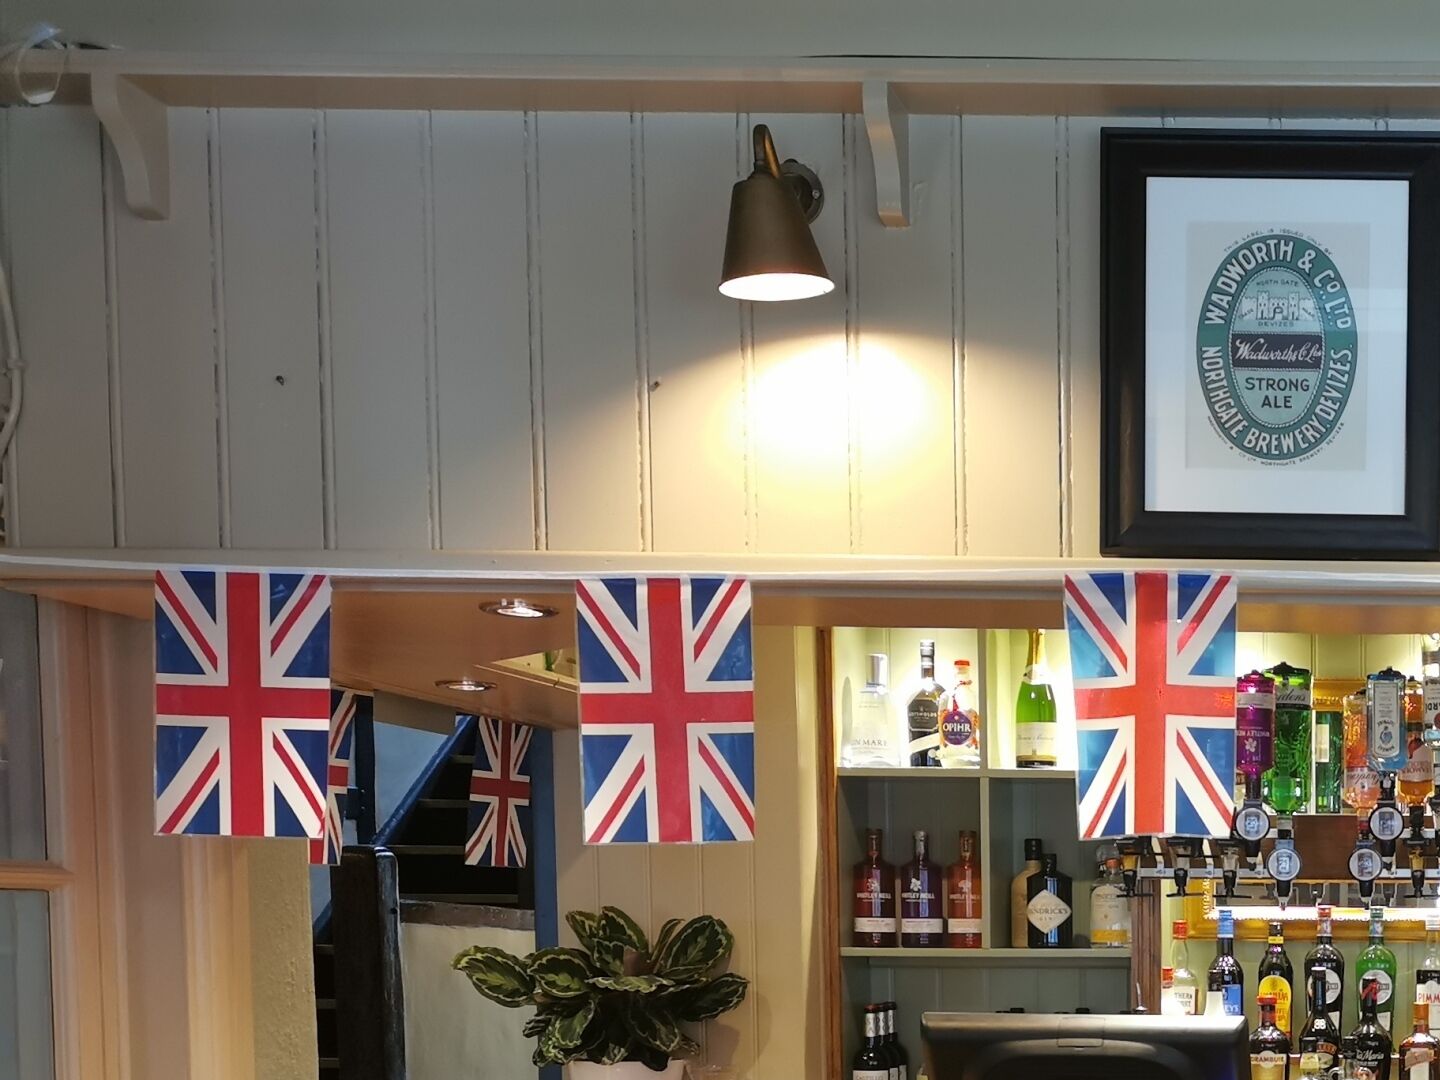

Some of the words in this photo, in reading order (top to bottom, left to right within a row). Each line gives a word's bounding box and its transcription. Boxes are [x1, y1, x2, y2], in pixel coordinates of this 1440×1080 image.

[1204, 239, 1295, 325] WADWORTH
[1297, 249, 1316, 273] &
[1256, 279, 1278, 287] NORTH
[1280, 279, 1299, 287] GATE
[1245, 377, 1310, 392] STRONG
[1201, 346, 1248, 438] NORTHGATE
[1261, 395, 1293, 409] ALE
[943, 722, 971, 732] OPIHR
